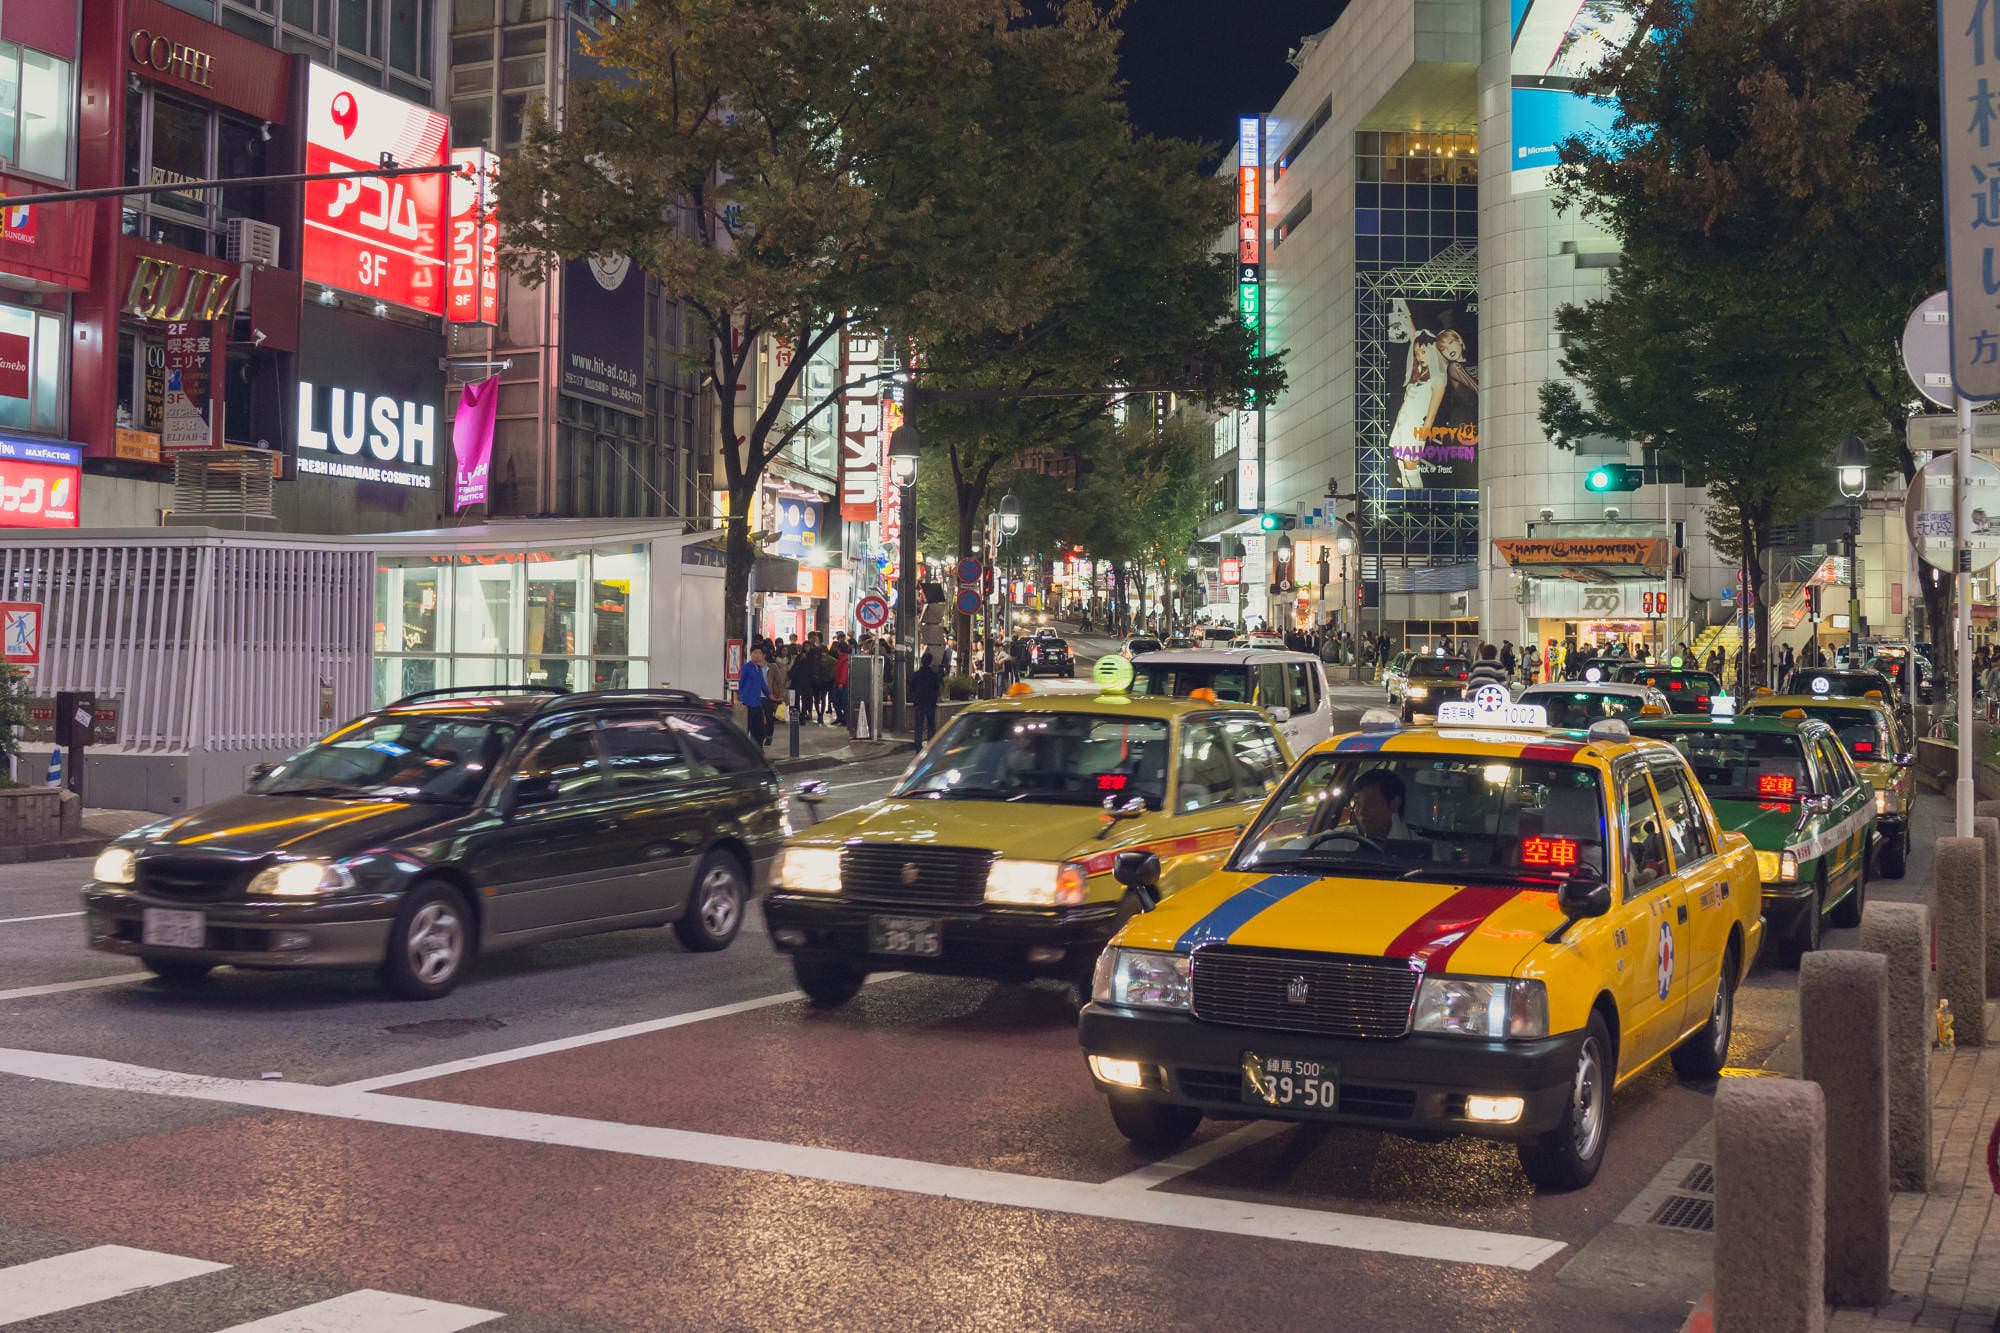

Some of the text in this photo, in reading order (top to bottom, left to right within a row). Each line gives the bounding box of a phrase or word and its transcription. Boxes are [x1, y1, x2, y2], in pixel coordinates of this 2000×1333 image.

[130, 28, 217, 89] COFFEE
[327, 161, 418, 240] アコム
[453, 221, 475, 287] アコム
[482, 223, 497, 290] アコム
[358, 251, 388, 287] 3F
[455, 294, 471, 306] 3F
[168, 323, 188, 335] 2F
[167, 337, 211, 354] 喫茶室
[171, 355, 207, 369] エリヤ
[571, 353, 638, 388] www.hit-ad.co.jp
[167, 393, 185, 405] 3F
[298, 381, 435, 466] LUSH
[1413, 426, 1458, 442] HAPPY
[1392, 445, 1475, 463] HALLOWEEN
[297, 457, 431, 489] FRESH HANDMADE COSMETICS
[1515, 544, 1637, 557] HAPPY HALLOWEEN
[1582, 594, 1620, 616] 109
[1504, 708, 1535, 724] 1002
[1759, 776, 1794, 793] 空車
[1523, 838, 1576, 866] 空車
[1266, 1058, 1320, 1077] 練馬 500
[1263, 1075, 1335, 1108] 39-50
